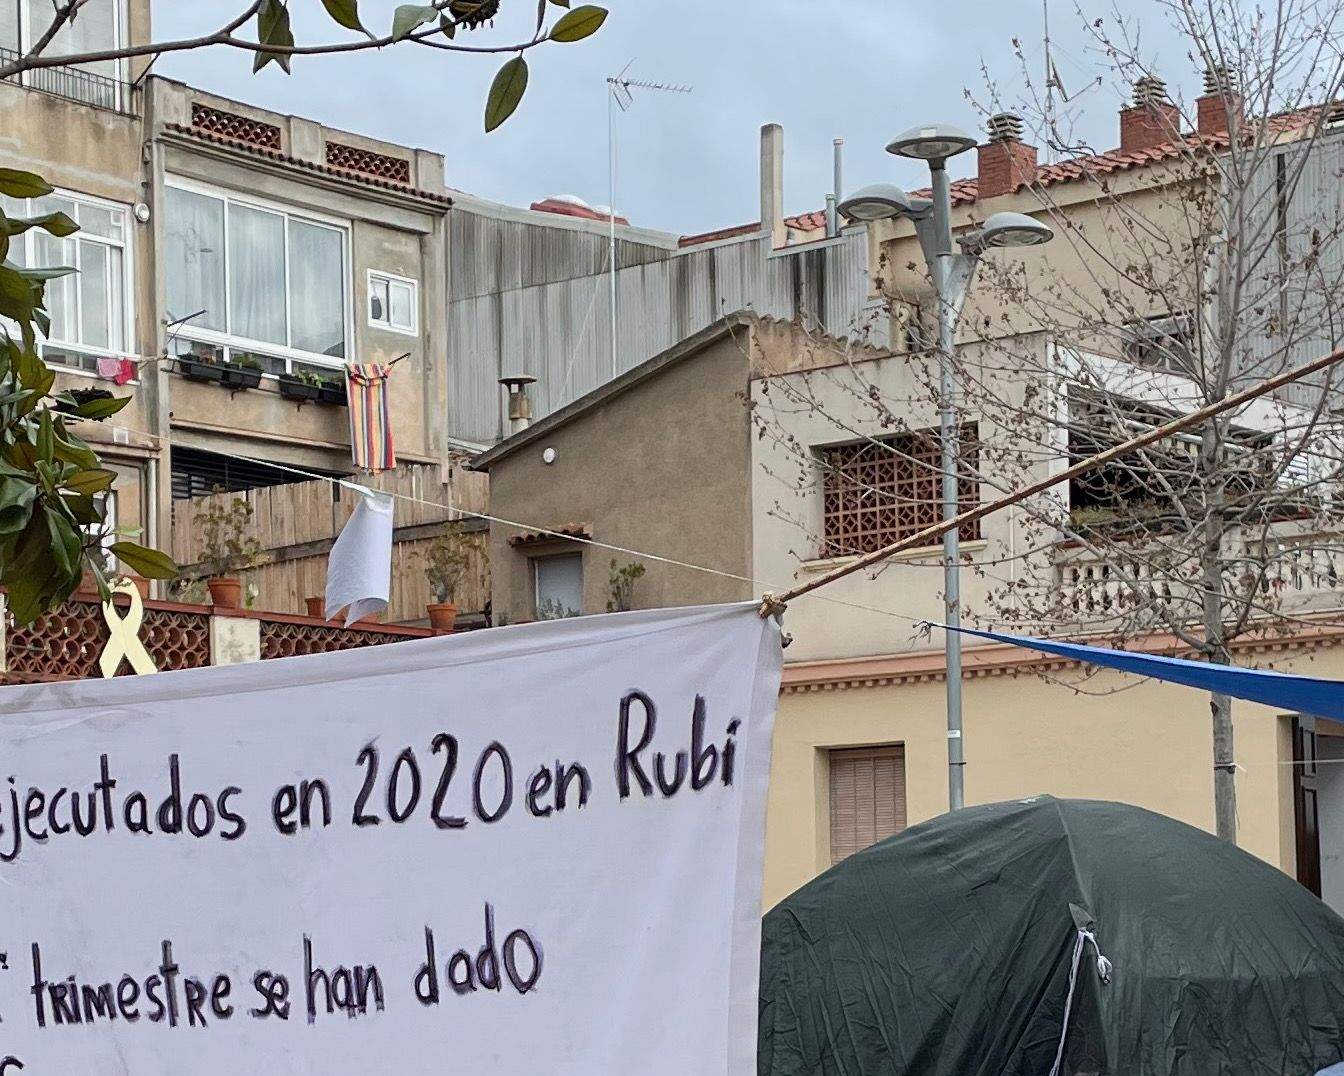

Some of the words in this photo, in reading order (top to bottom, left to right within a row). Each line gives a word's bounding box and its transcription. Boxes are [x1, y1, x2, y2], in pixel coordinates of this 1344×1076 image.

[272, 777, 332, 837] en
[351, 731, 515, 830] 2020
[525, 757, 593, 818] en
[252, 966, 291, 1022] se
[302, 932, 386, 1026] han
[414, 901, 545, 1006] dado
